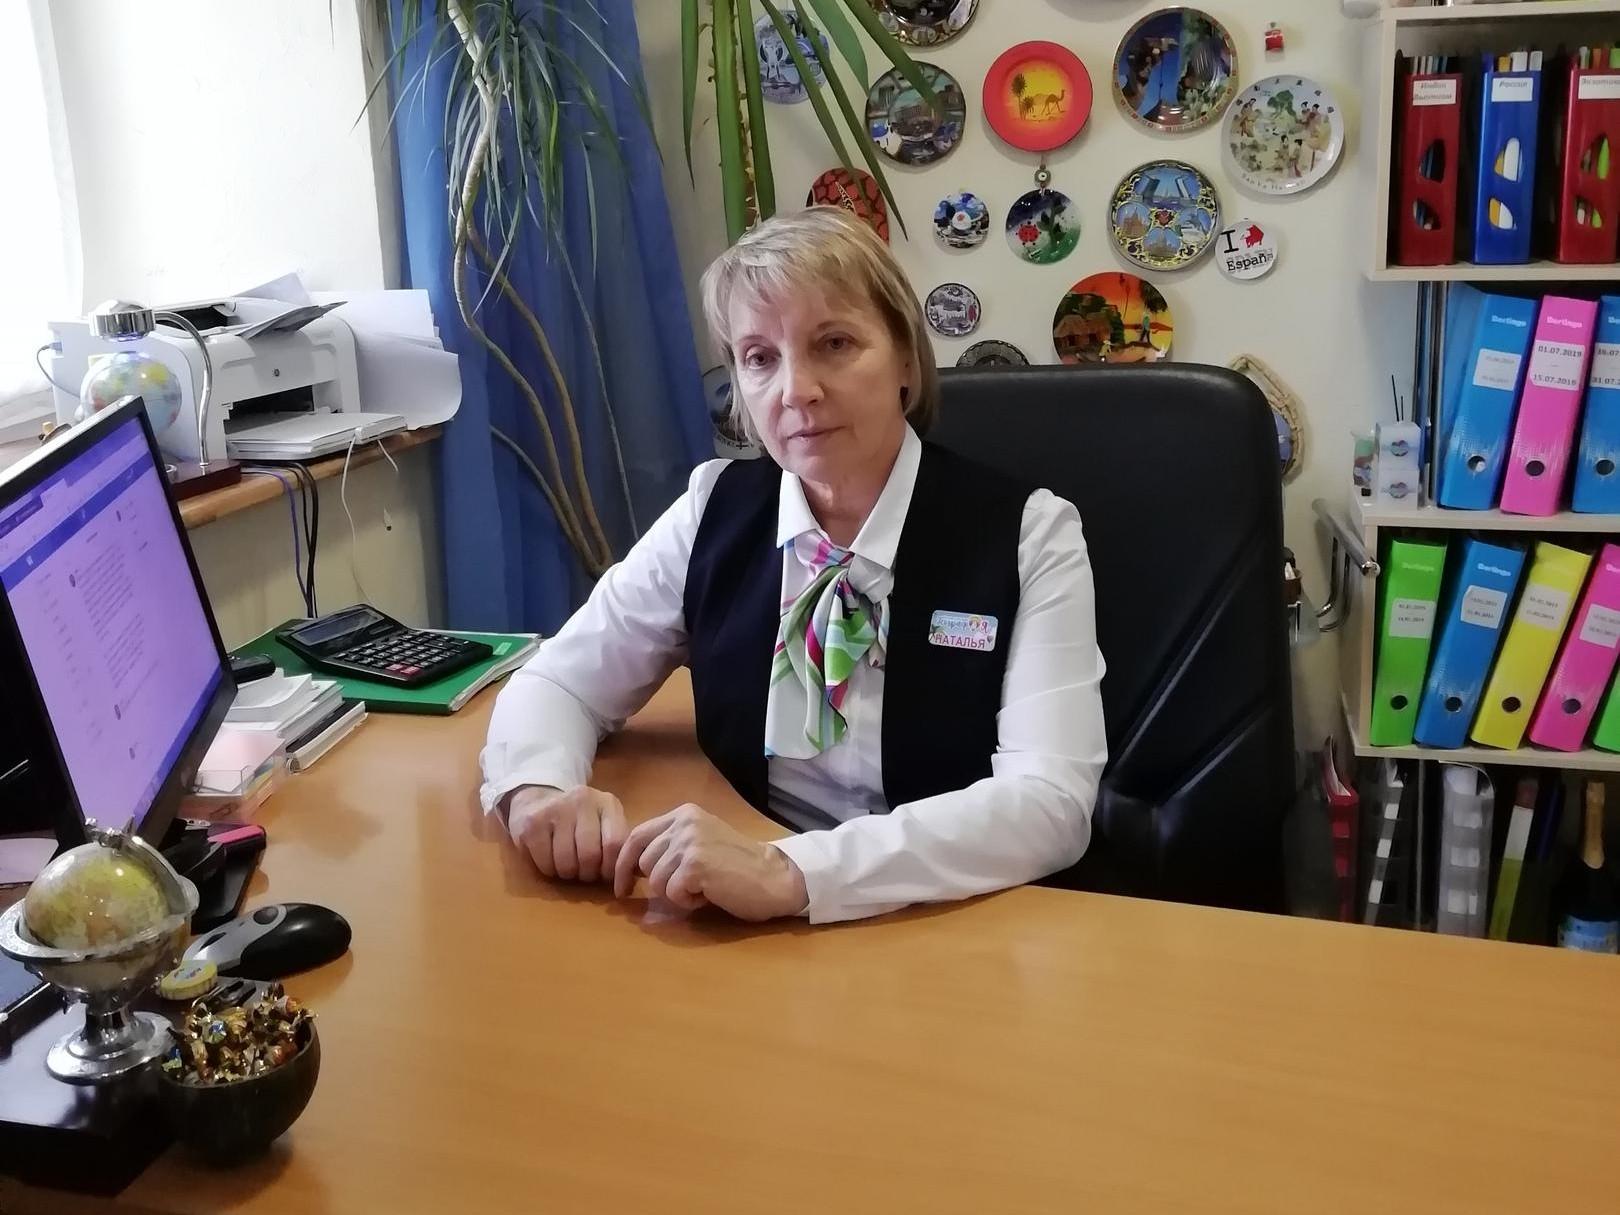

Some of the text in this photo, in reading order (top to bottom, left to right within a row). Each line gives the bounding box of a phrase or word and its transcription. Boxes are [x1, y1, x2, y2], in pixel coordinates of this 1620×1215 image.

[1220, 229, 1239, 254] I
[1537, 345, 1582, 357] 01.07.2019
[935, 634, 986, 649] НАТАЛЬЯ
